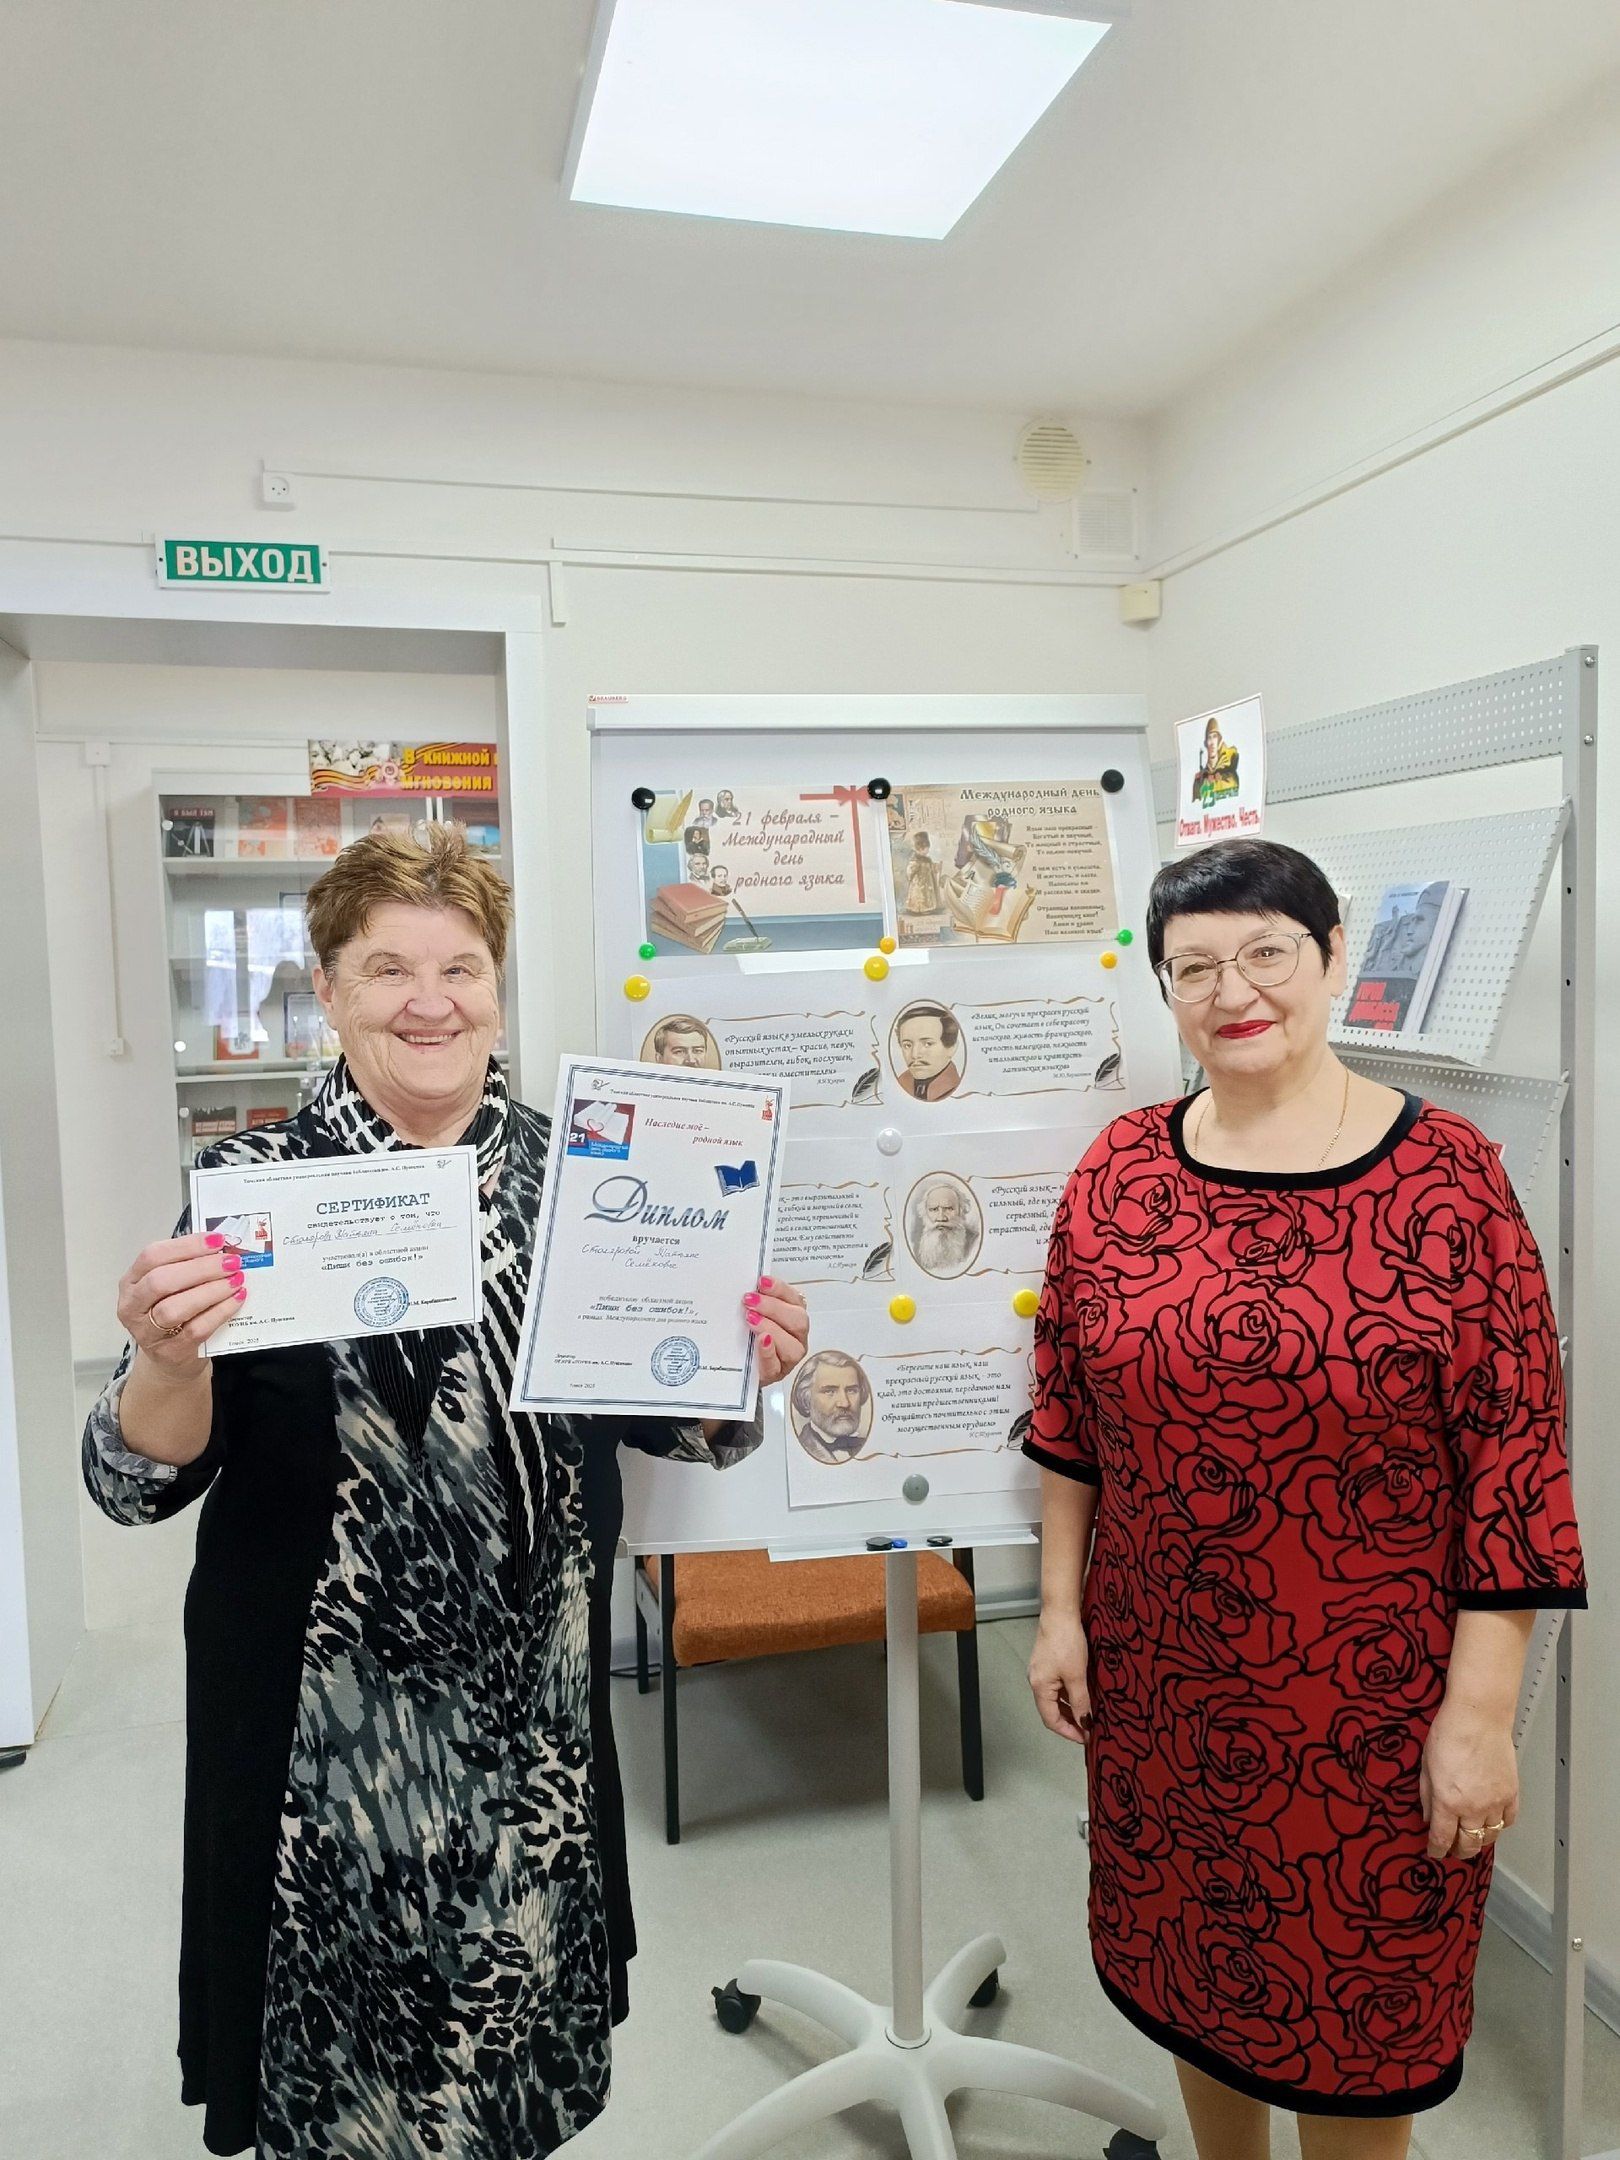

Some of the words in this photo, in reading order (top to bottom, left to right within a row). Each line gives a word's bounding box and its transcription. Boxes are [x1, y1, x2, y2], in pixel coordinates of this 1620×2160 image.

[176, 546, 314, 583] ВЫХОД
[403, 747, 416, 765] В
[423, 749, 491, 766] книжной
[400, 775, 492, 792] мгновения
[960, 788, 1067, 802] Международный
[1072, 789, 1100, 798] день
[988, 806, 1036, 818] родного
[1039, 805, 1077, 814] языка
[732, 811, 752, 826] 21
[761, 809, 822, 830] февраля
[722, 829, 844, 852] Международный
[774, 851, 804, 865] день
[733, 872, 793, 894] родного
[799, 873, 845, 891] языка
[725, 1033, 762, 1045] «Русский
[645, 1118, 685, 1131] Наследие
[686, 1123, 703, 1131] моё
[569, 1132, 586, 1143] 21
[692, 1136, 722, 1145] родной
[723, 1139, 743, 1147] язык
[992, 1185, 1028, 1196] «Русский
[1029, 1185, 1052, 1193] язык
[316, 1193, 430, 1215] СЕРТИФИКАТ
[584, 1175, 730, 1230] Диплом
[989, 1198, 1026, 1208] сильный,
[1028, 1197, 1040, 1206] где
[307, 1215, 385, 1229] свидетельствует
[1006, 1210, 1049, 1222] серьезный,
[989, 1224, 1037, 1236] страстный,
[632, 1235, 680, 1245] вручается
[321, 1262, 351, 1271] «Пиши
[379, 1253, 423, 1264] ошибок!»
[590, 1303, 621, 1311] «Пиши
[886, 1375, 929, 1387] прекрасный
[930, 1374, 958, 1384] русский
[996, 1383, 1011, 1391] нам
[891, 1401, 922, 1409] нашими
[881, 1413, 933, 1425] Обращайтесь
[897, 1422, 961, 1435] могущественным
